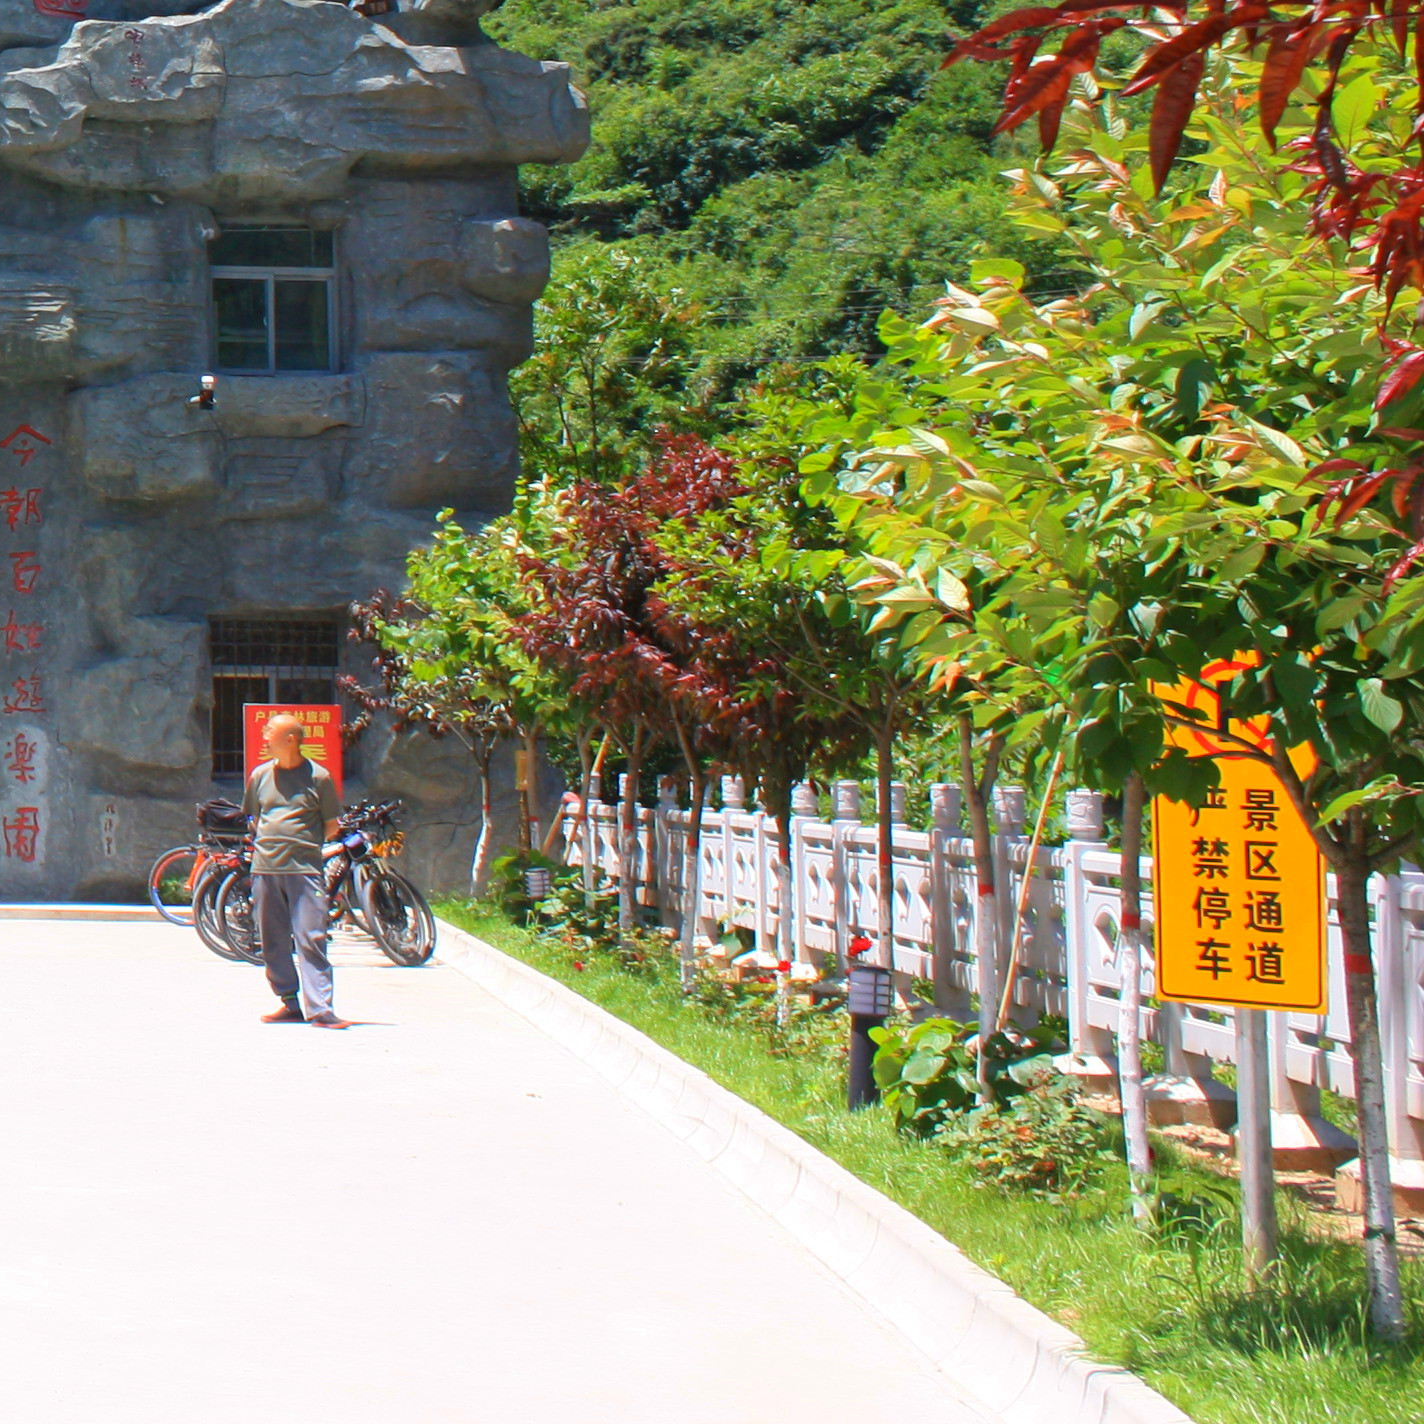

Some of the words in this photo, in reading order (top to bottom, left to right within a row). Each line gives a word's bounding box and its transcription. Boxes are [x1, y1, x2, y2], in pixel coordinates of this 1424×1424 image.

[255, 710, 331, 723] 户林旅游
[1190, 785, 1233, 981] 严禁停车
[1240, 789, 1285, 985] 景区通道
